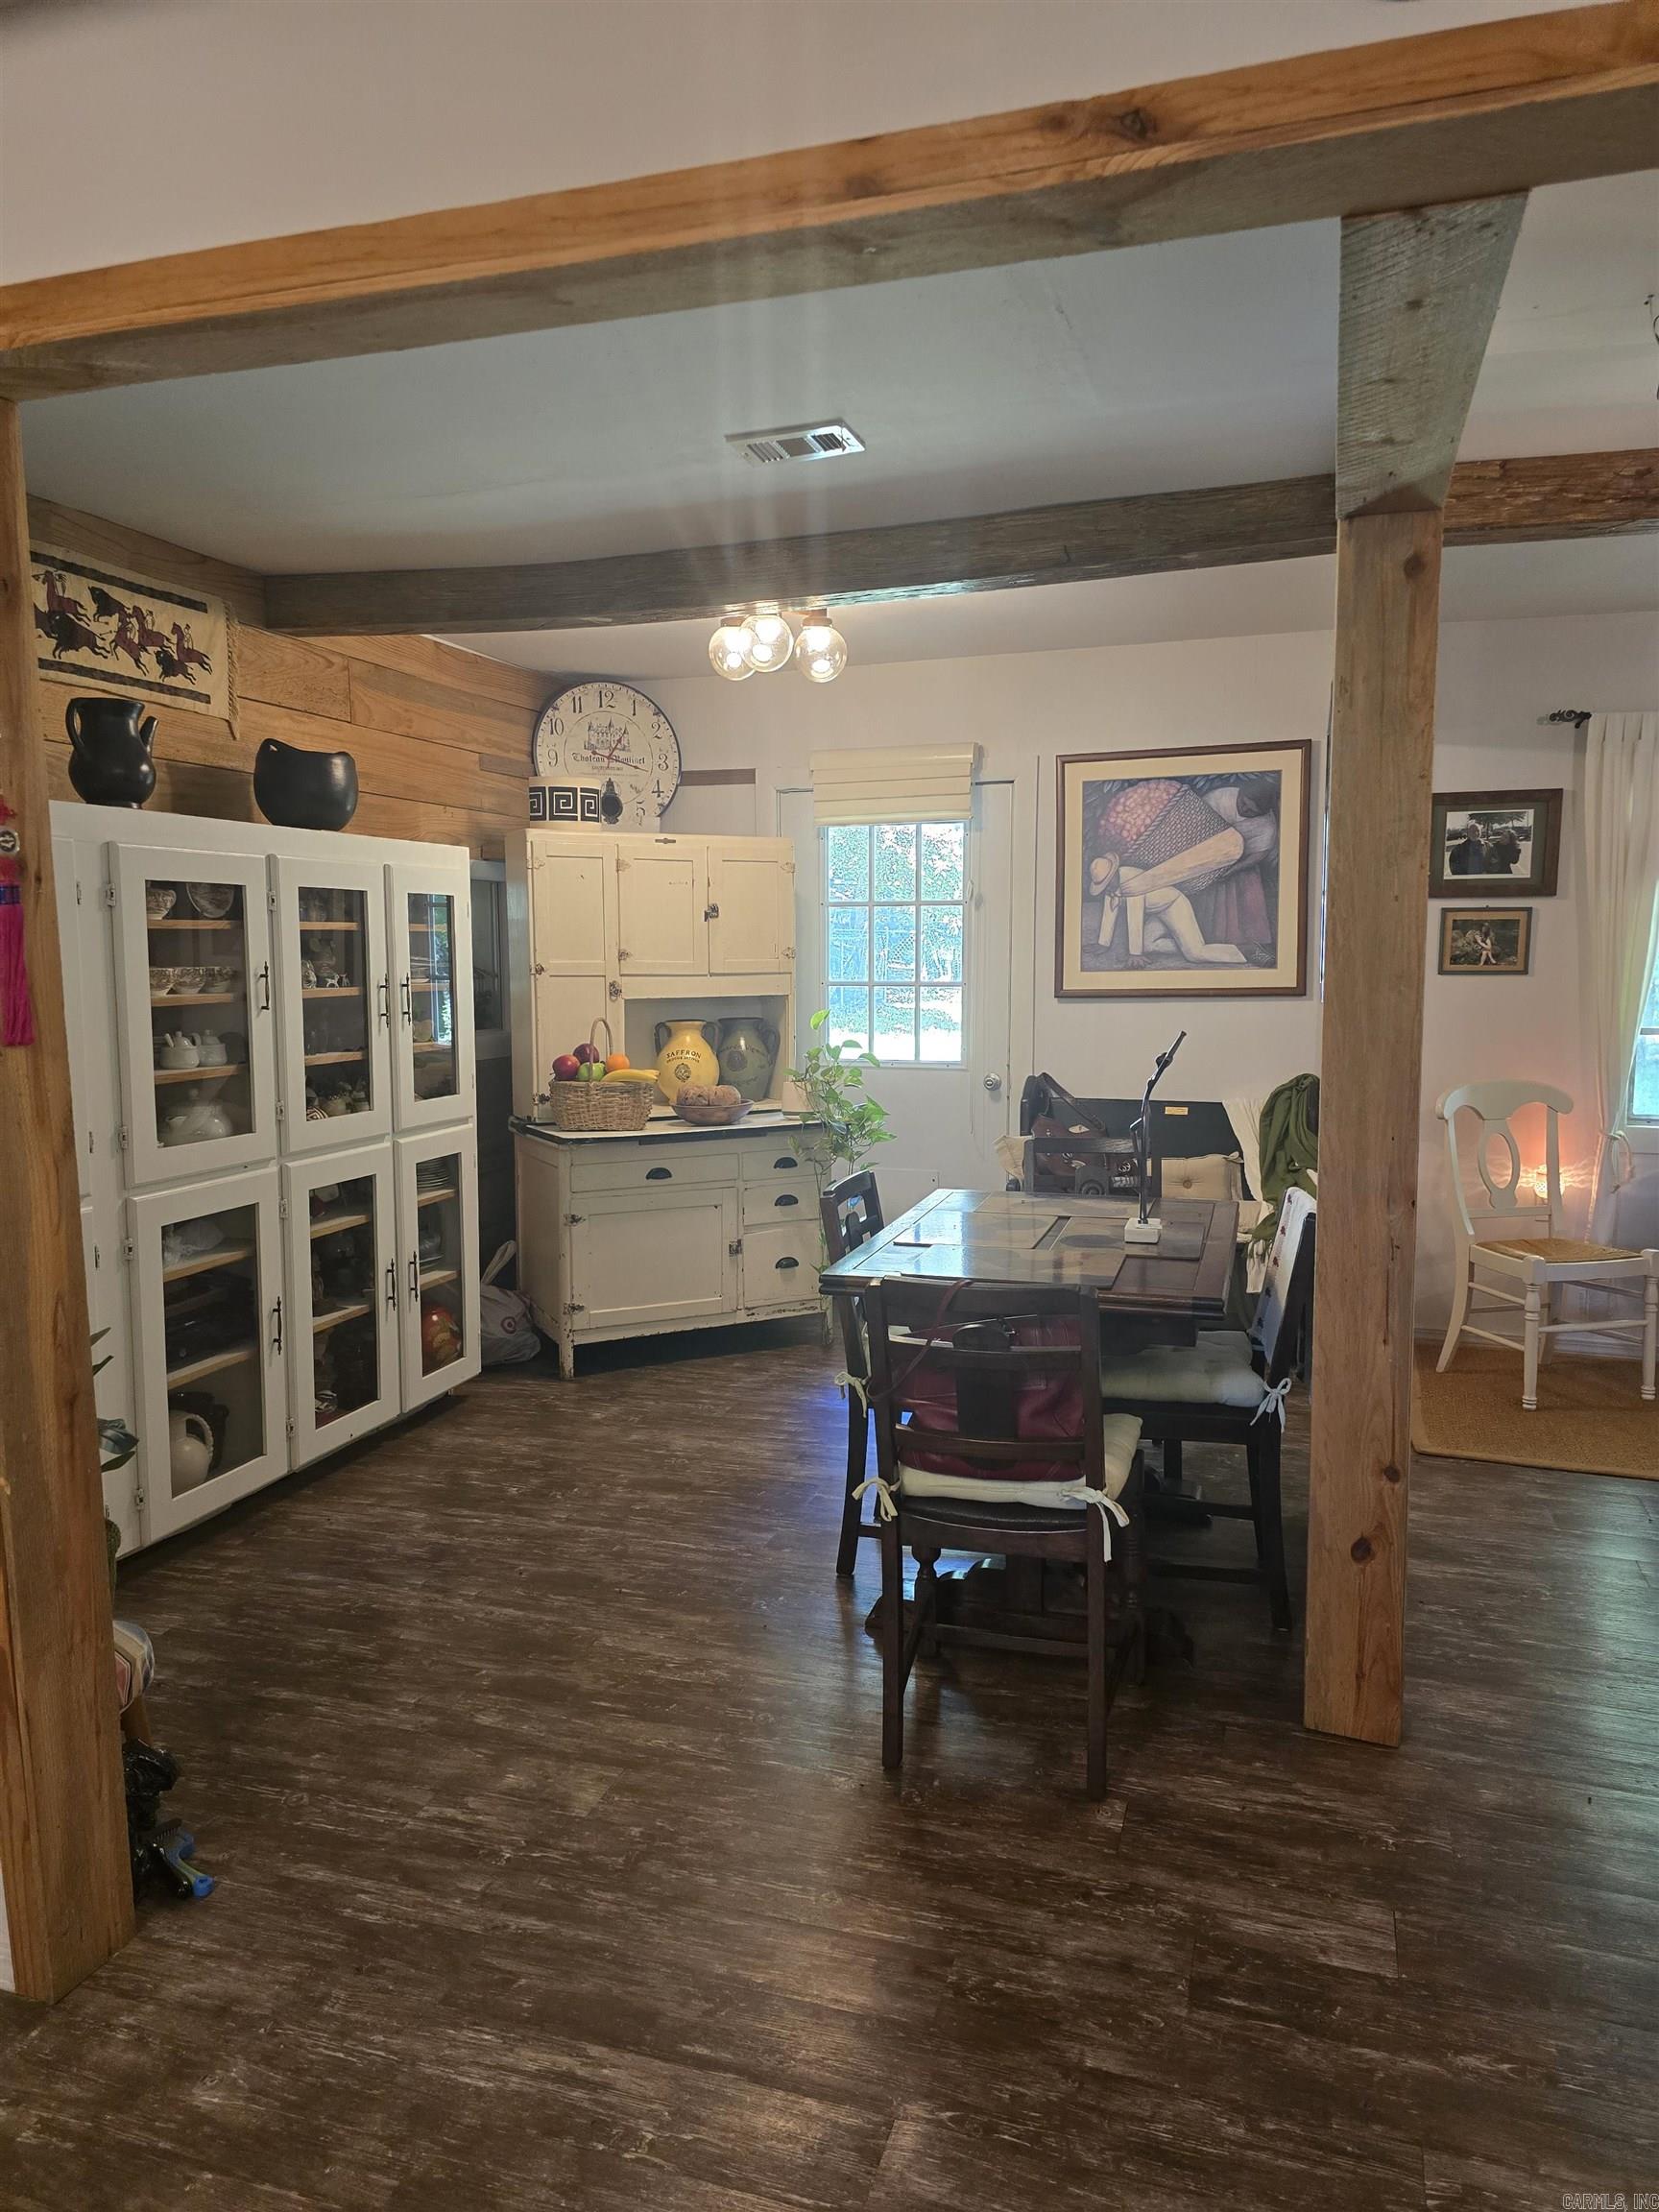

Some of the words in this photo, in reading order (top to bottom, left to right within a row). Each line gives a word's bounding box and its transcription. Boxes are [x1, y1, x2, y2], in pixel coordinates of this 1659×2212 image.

[572, 696, 583, 713] 11
[598, 689, 616, 709] 12
[632, 699, 637, 716] 1
[549, 717, 565, 735] 10
[651, 721, 662, 739] 2
[547, 749, 559, 767] 9
[658, 753, 669, 771] 3
[651, 779, 665, 798] 4
[666, 1049, 702, 1059] SAFFRON
